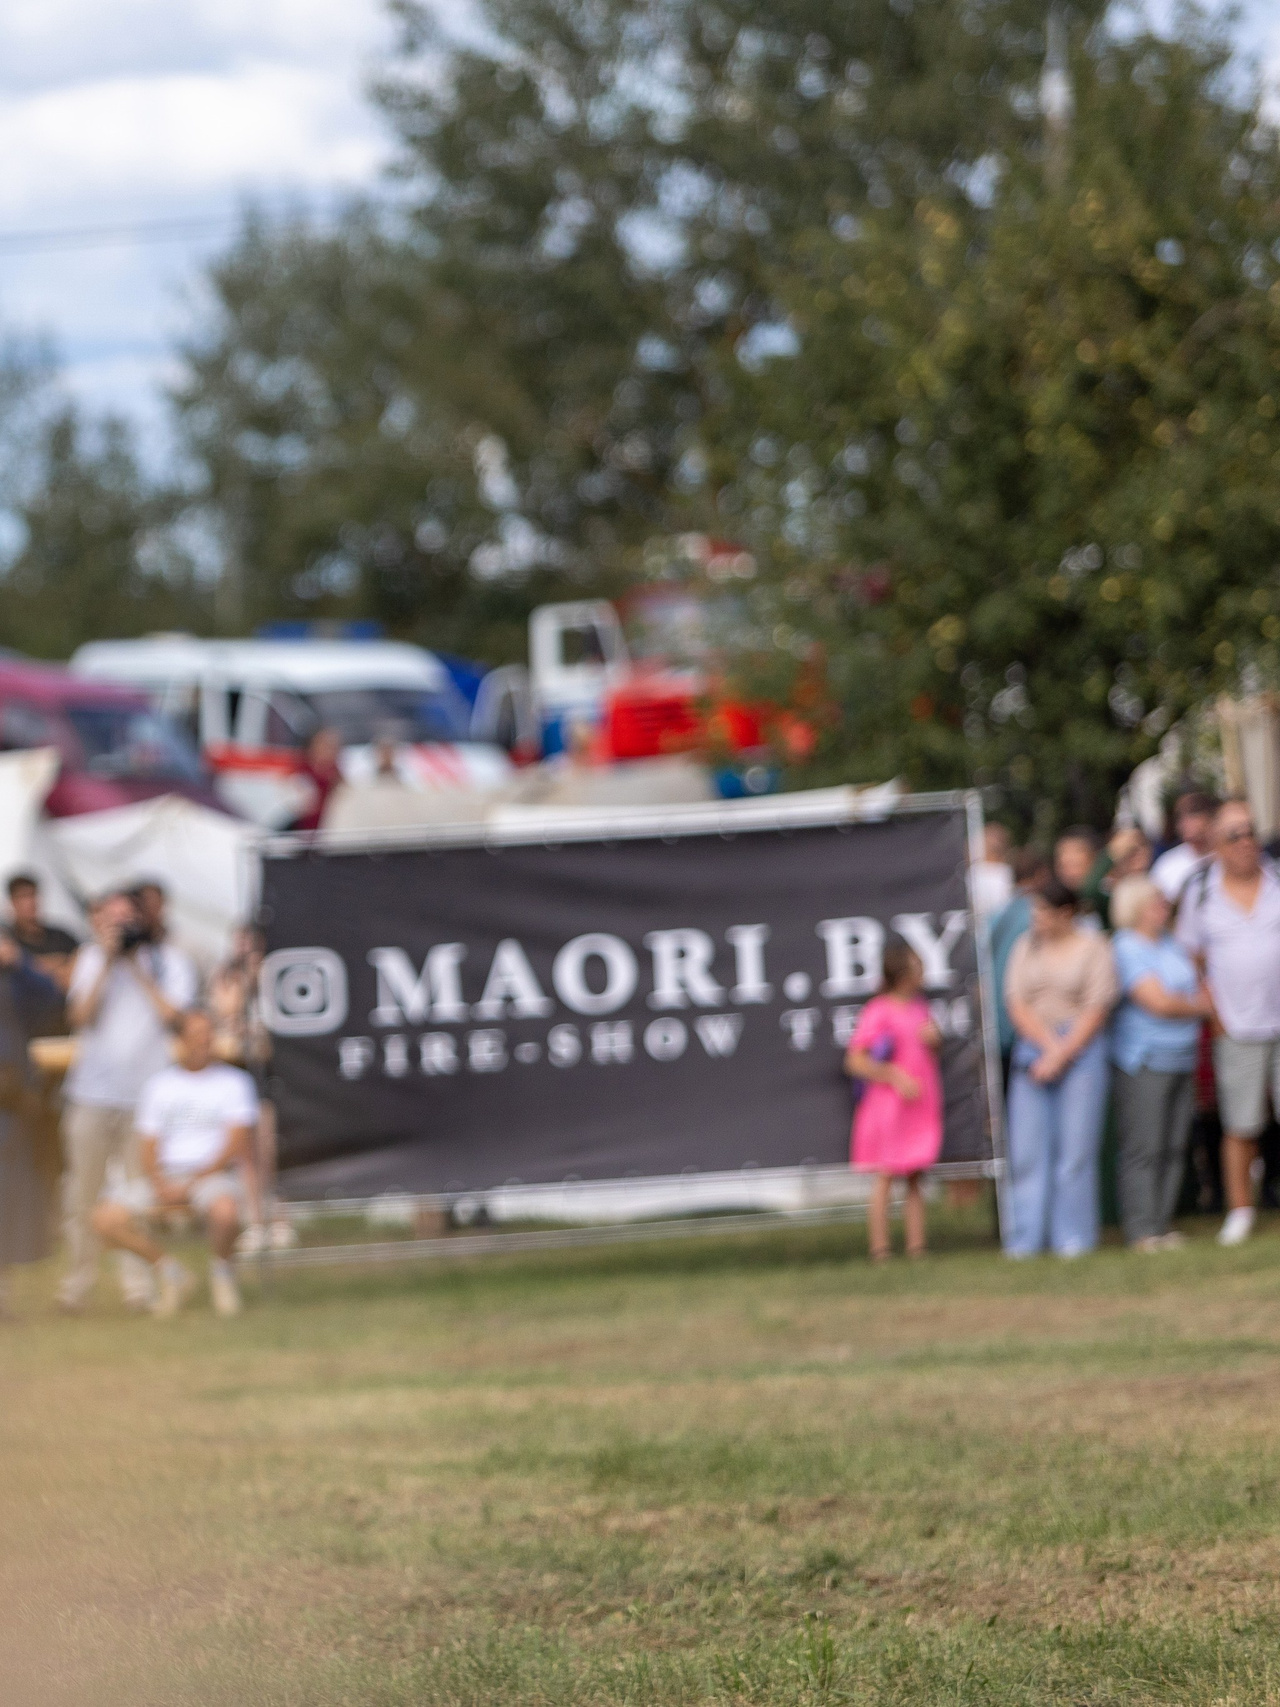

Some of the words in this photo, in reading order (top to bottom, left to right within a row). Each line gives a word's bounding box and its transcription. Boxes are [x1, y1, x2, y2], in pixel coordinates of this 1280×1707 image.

[368, 909, 968, 1025] MAORI.BY
[338, 1013, 743, 1080] FIRE-SHOW
[779, 995, 971, 1050] TEM
